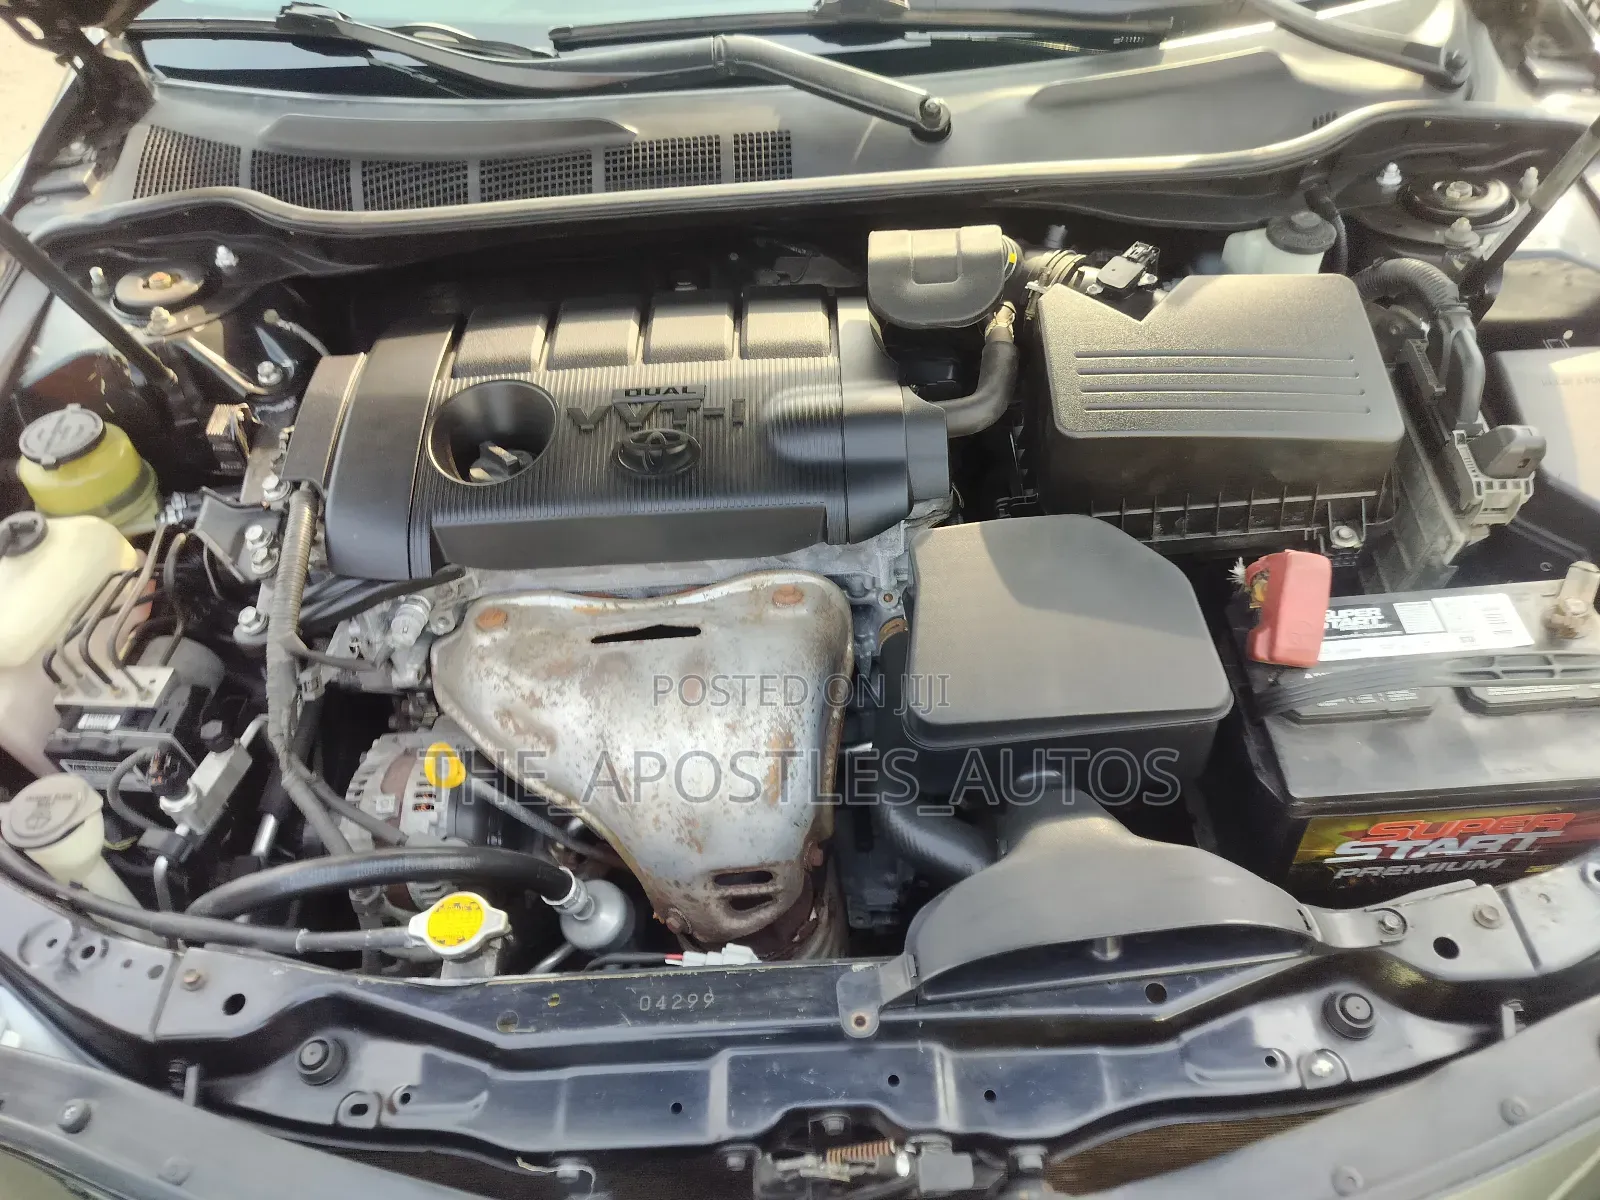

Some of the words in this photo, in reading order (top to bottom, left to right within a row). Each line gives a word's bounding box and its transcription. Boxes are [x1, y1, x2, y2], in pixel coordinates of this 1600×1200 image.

[624, 385, 697, 397] DUAL
[1360, 812, 1576, 842] SUPER
[1323, 830, 1563, 864] START
[1333, 858, 1506, 879] PREMIUM
[639, 992, 715, 1011] 04299
